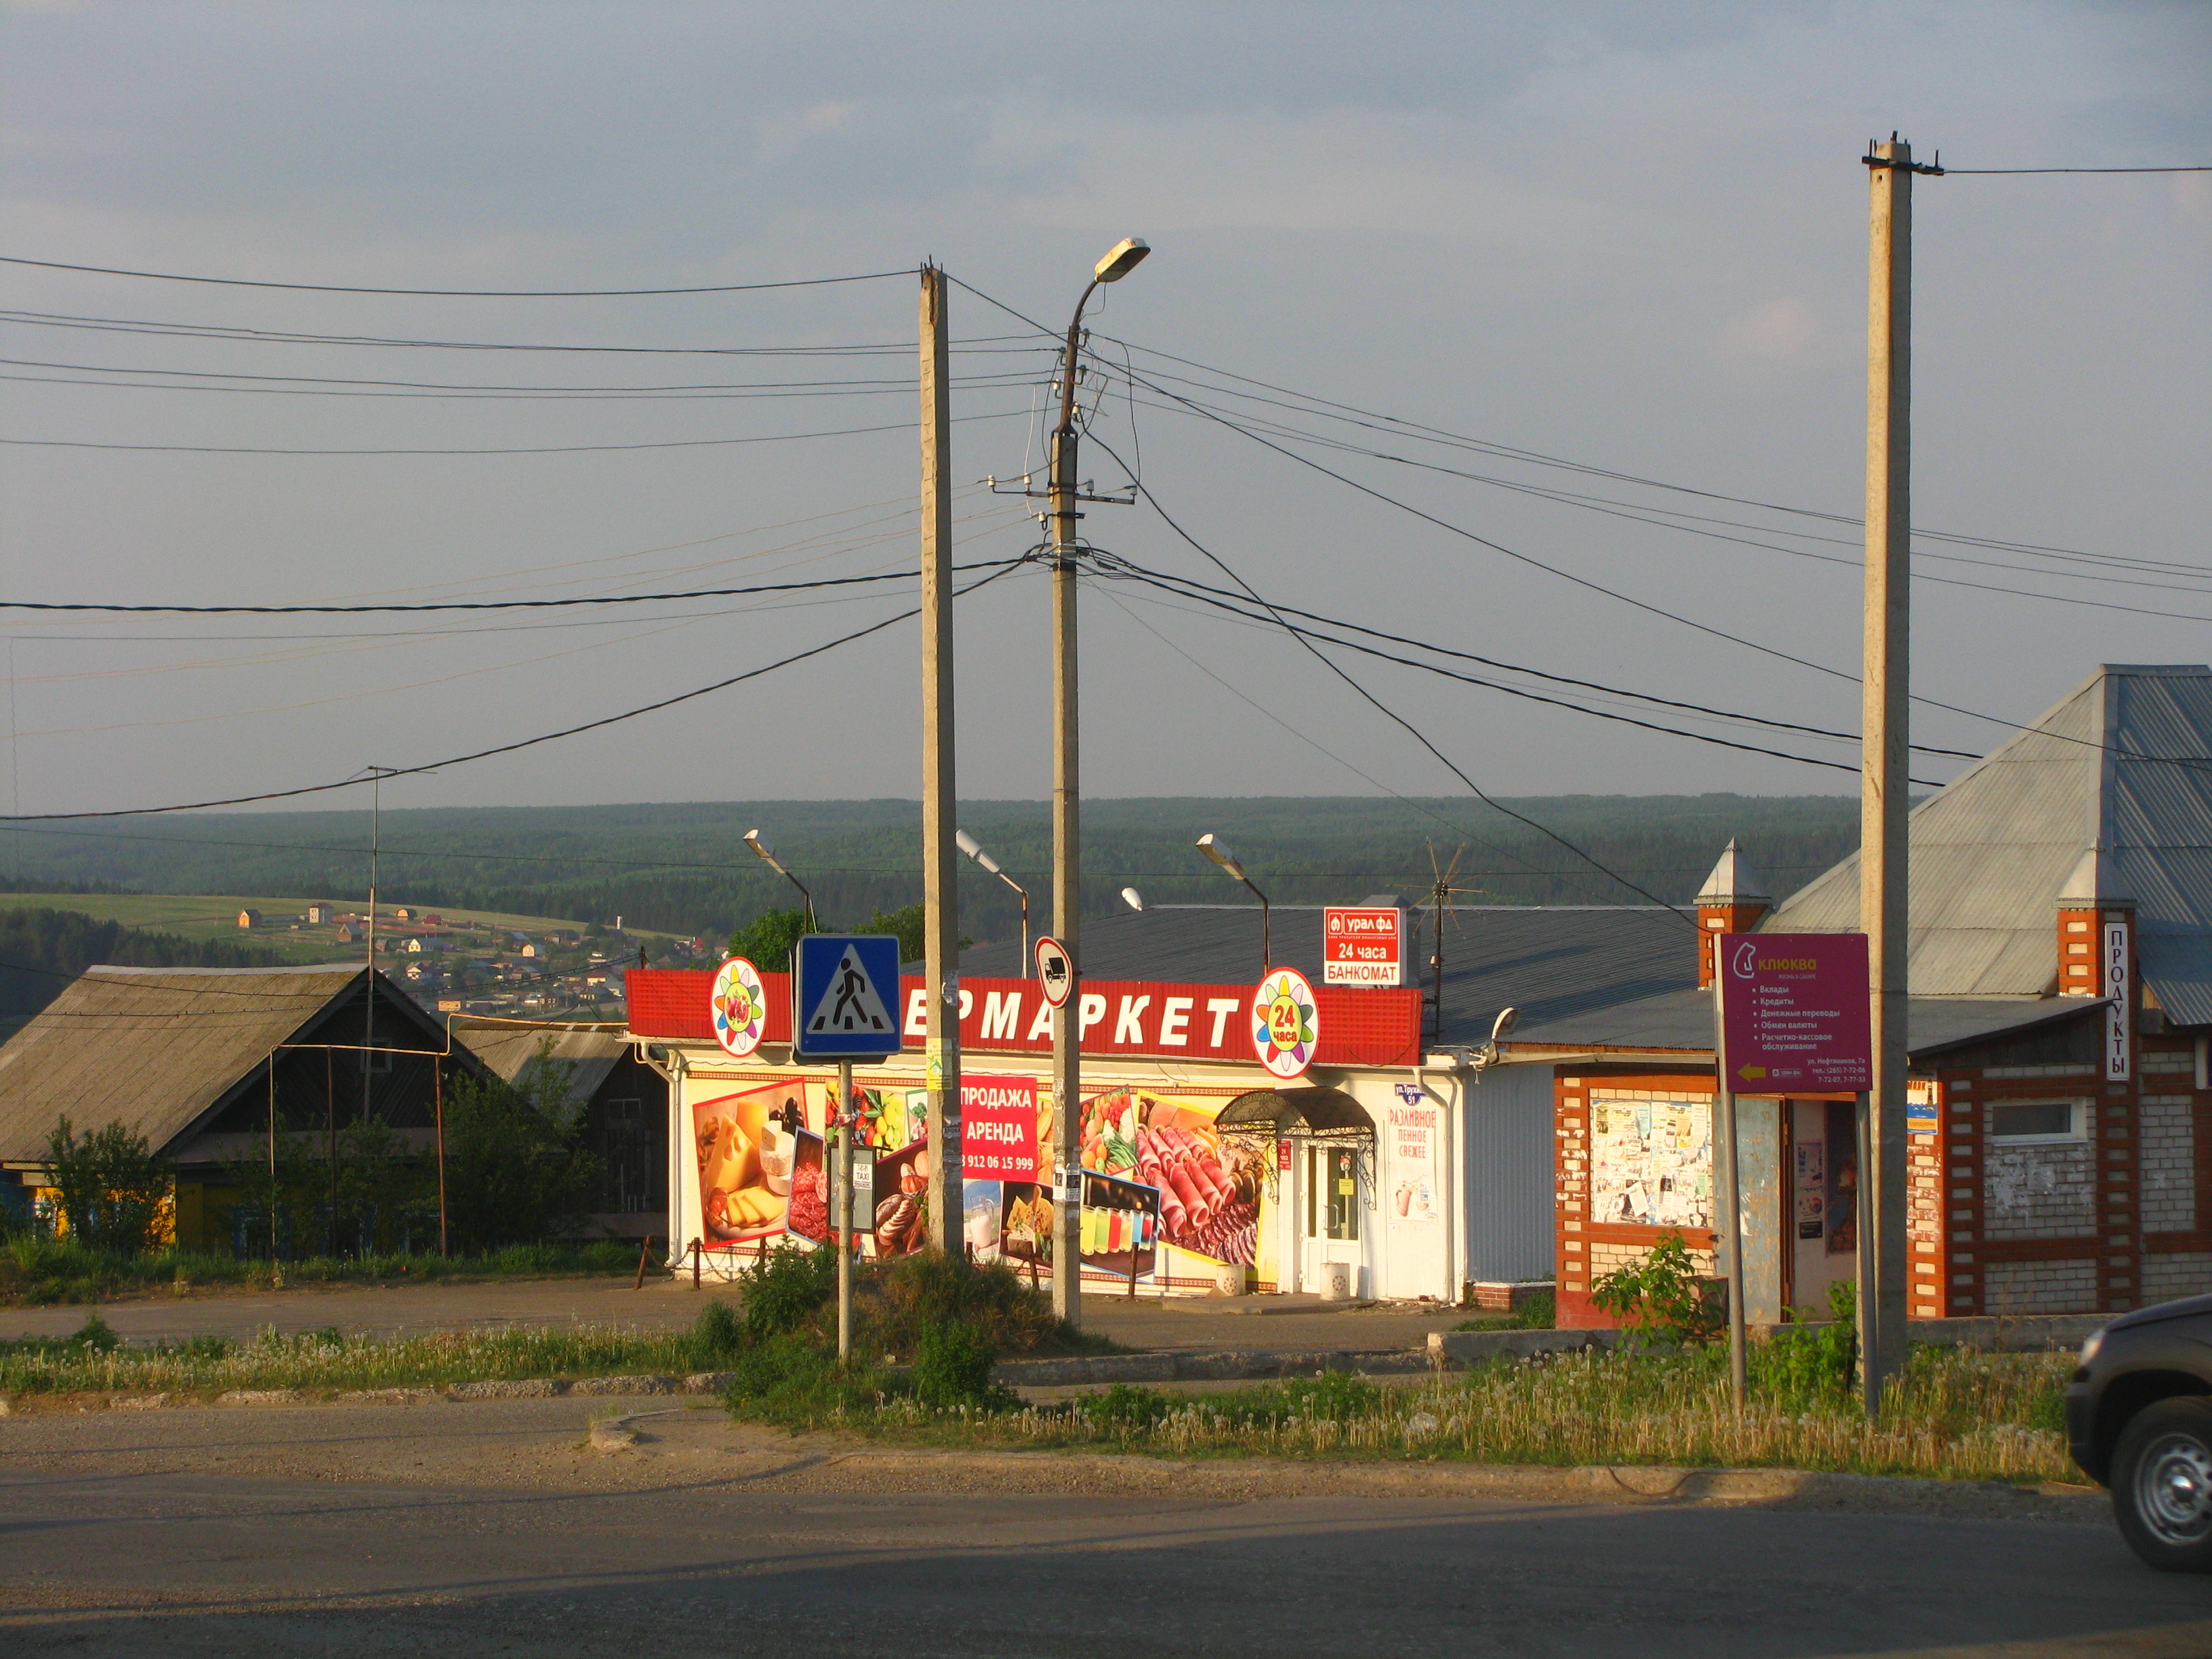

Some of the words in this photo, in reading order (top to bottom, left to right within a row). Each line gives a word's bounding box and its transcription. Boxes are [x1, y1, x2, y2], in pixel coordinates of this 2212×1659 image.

[1347, 918, 1375, 932] урал
[1338, 943, 1354, 959] 24
[1357, 947, 1387, 959] часа
[1328, 965, 1397, 981] БАНКОМАТ
[1760, 998, 1794, 1006] Кредиты
[2110, 930, 2125, 1073] ПРОДУКТЫ
[1275, 1005, 1295, 1027] 24
[1761, 1009, 1801, 1018] Денежные
[1273, 1031, 1298, 1042] часа
[1761, 1033, 1832, 1042] Расчетно-кассовое
[1762, 1043, 1817, 1051] обслуживание
[960, 1087, 1033, 1110] ПРОДАЖА
[1408, 1096, 1416, 1105] 51
[1389, 1108, 1436, 1128] РАЗЛИВНОЕ
[966, 1122, 1025, 1145] АРЕНДА
[1398, 1129, 1427, 1143] ПЕННОЕ
[1399, 1145, 1427, 1159] СВЕЖЕЕ
[968, 1155, 985, 1168] 912
[987, 1155, 999, 1168] 06
[1002, 1156, 1013, 1170] 15
[1015, 1158, 1033, 1170] 999
